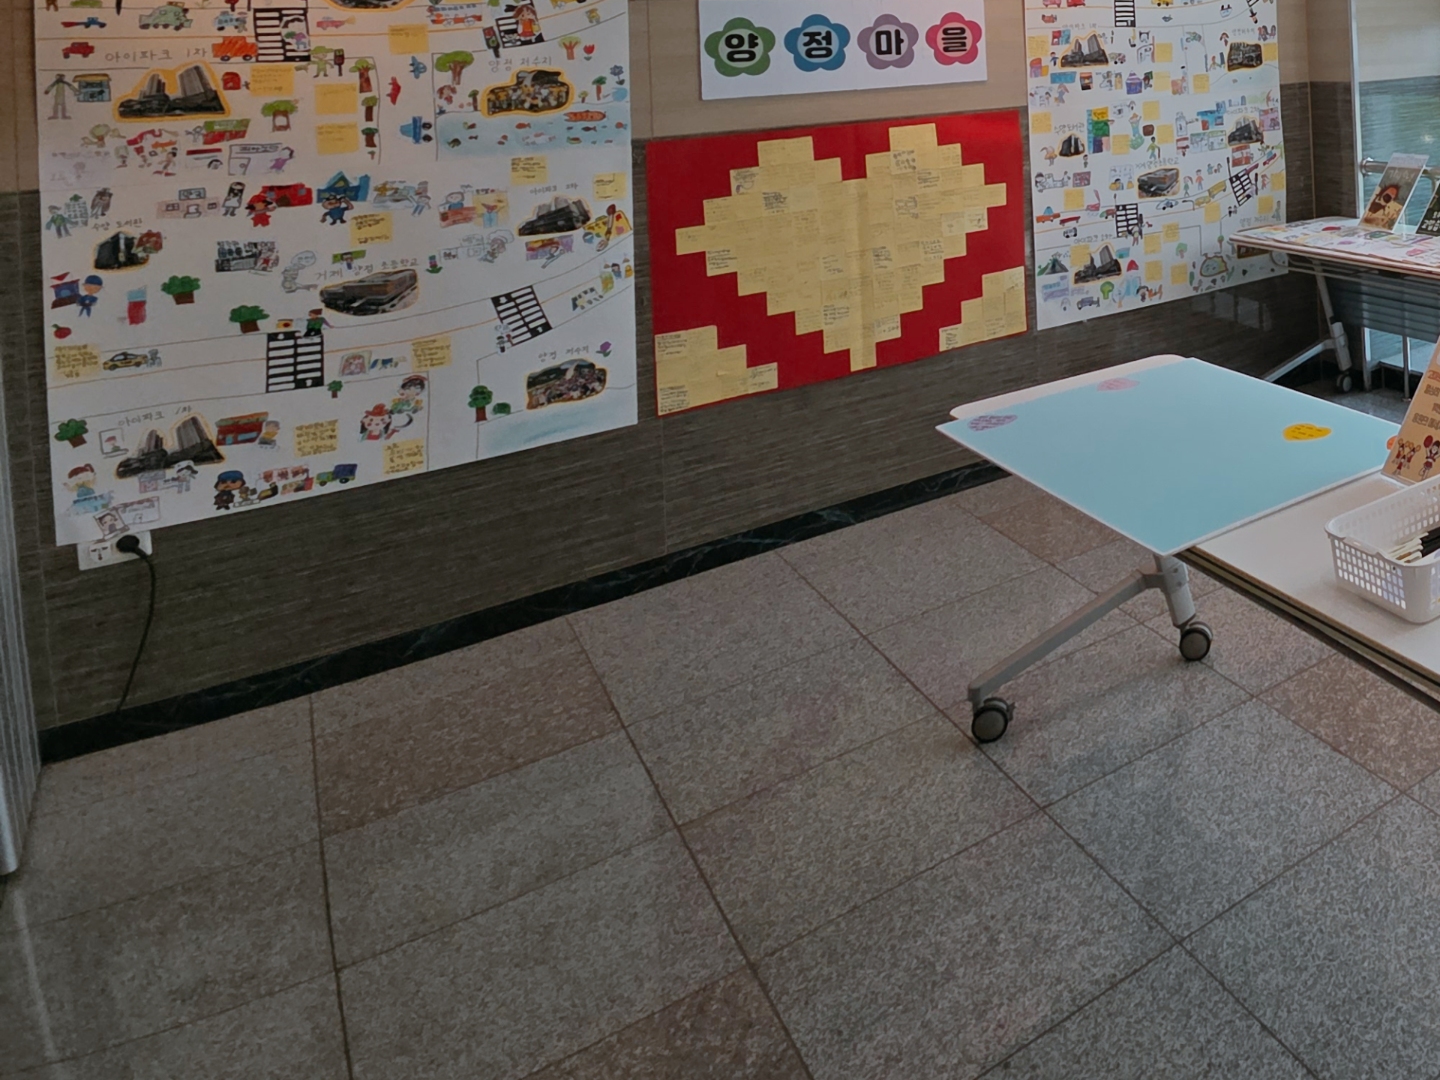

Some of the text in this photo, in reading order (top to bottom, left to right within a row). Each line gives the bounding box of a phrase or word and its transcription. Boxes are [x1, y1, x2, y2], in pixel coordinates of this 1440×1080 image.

[105, 47, 208, 63] 아이파크 1차
[488, 58, 513, 72] 양정
[315, 269, 344, 282] 거제
